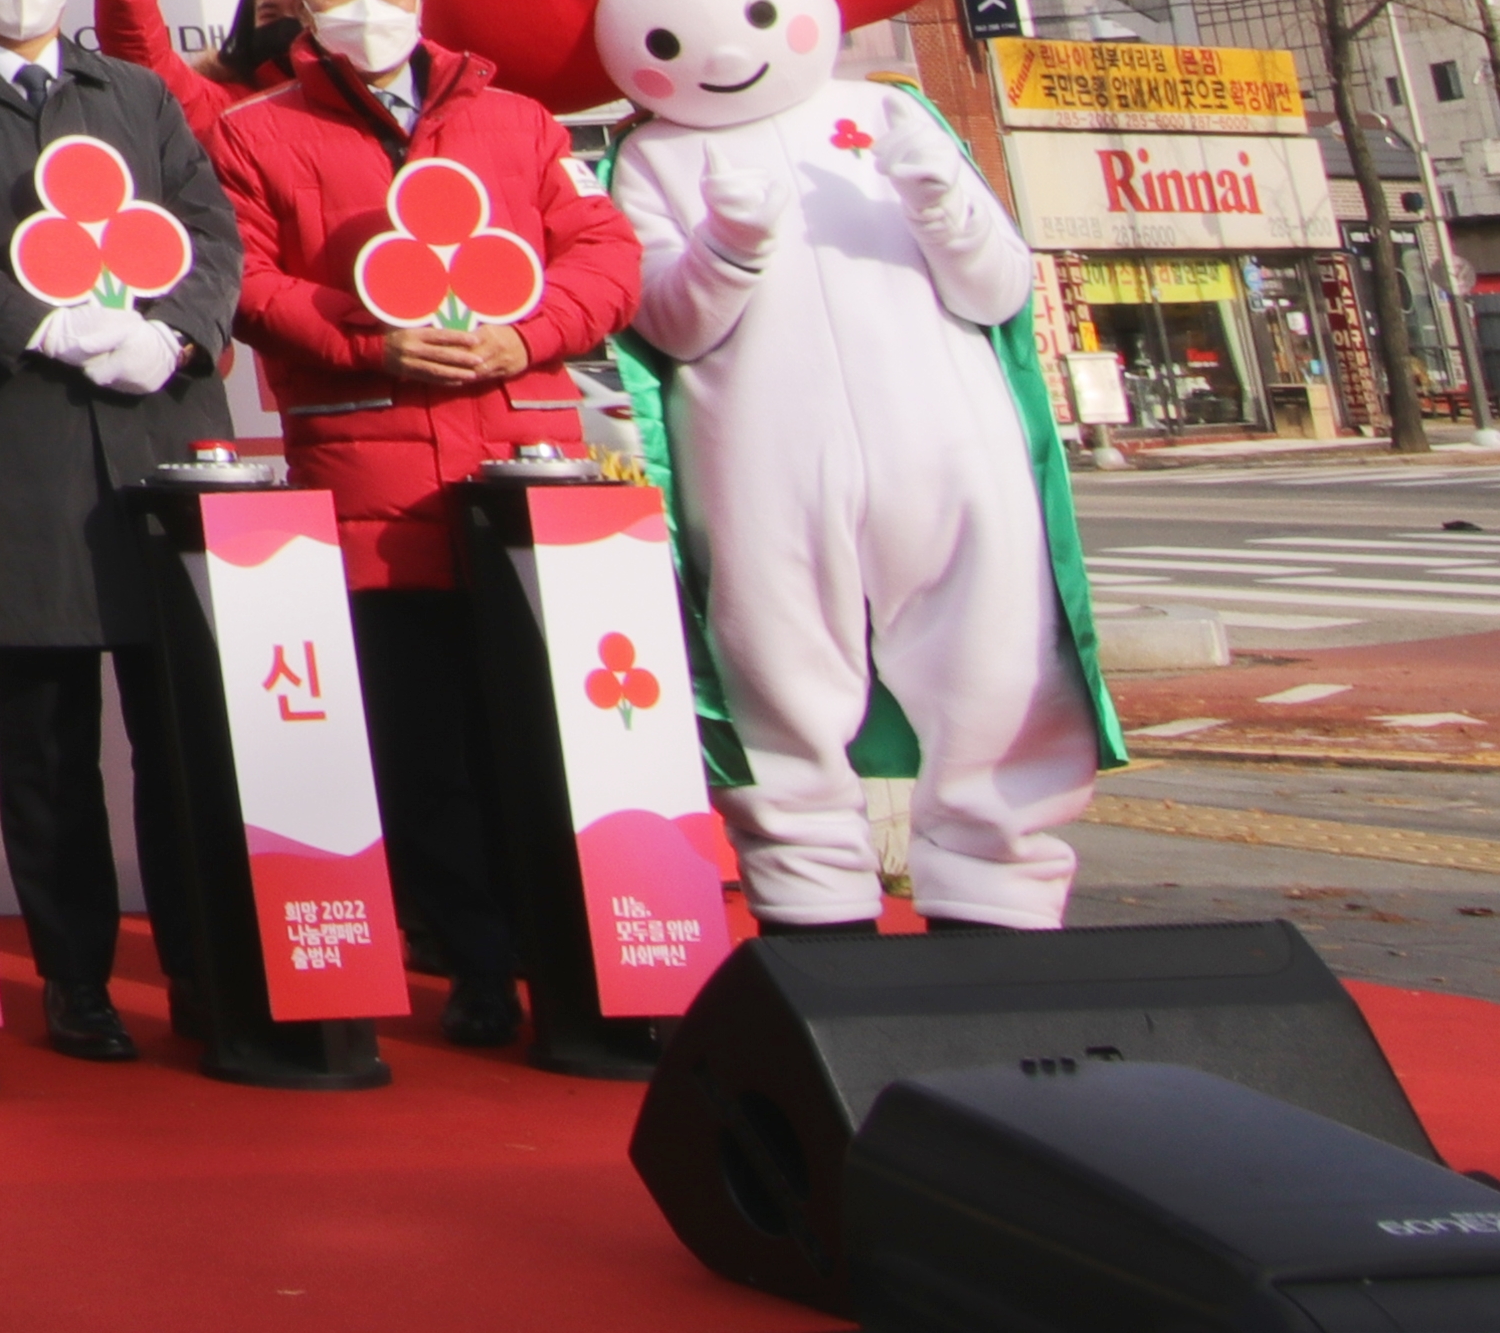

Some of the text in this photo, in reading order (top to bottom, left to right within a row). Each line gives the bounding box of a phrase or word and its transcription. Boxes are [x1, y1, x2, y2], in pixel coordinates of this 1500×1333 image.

[1039, 45, 1087, 69] 린나이
[1090, 47, 1167, 73] 전북대리점
[1041, 73, 1109, 108] 국민은행
[1096, 148, 1263, 214] Rinnai
[262, 640, 327, 722] 신
[284, 900, 366, 922] 희망 2022
[288, 922, 371, 944] 나눔캠페인
[616, 918, 701, 942] 모두를 위한
[291, 946, 341, 969] 출범식
[619, 944, 687, 966] 사회백신
